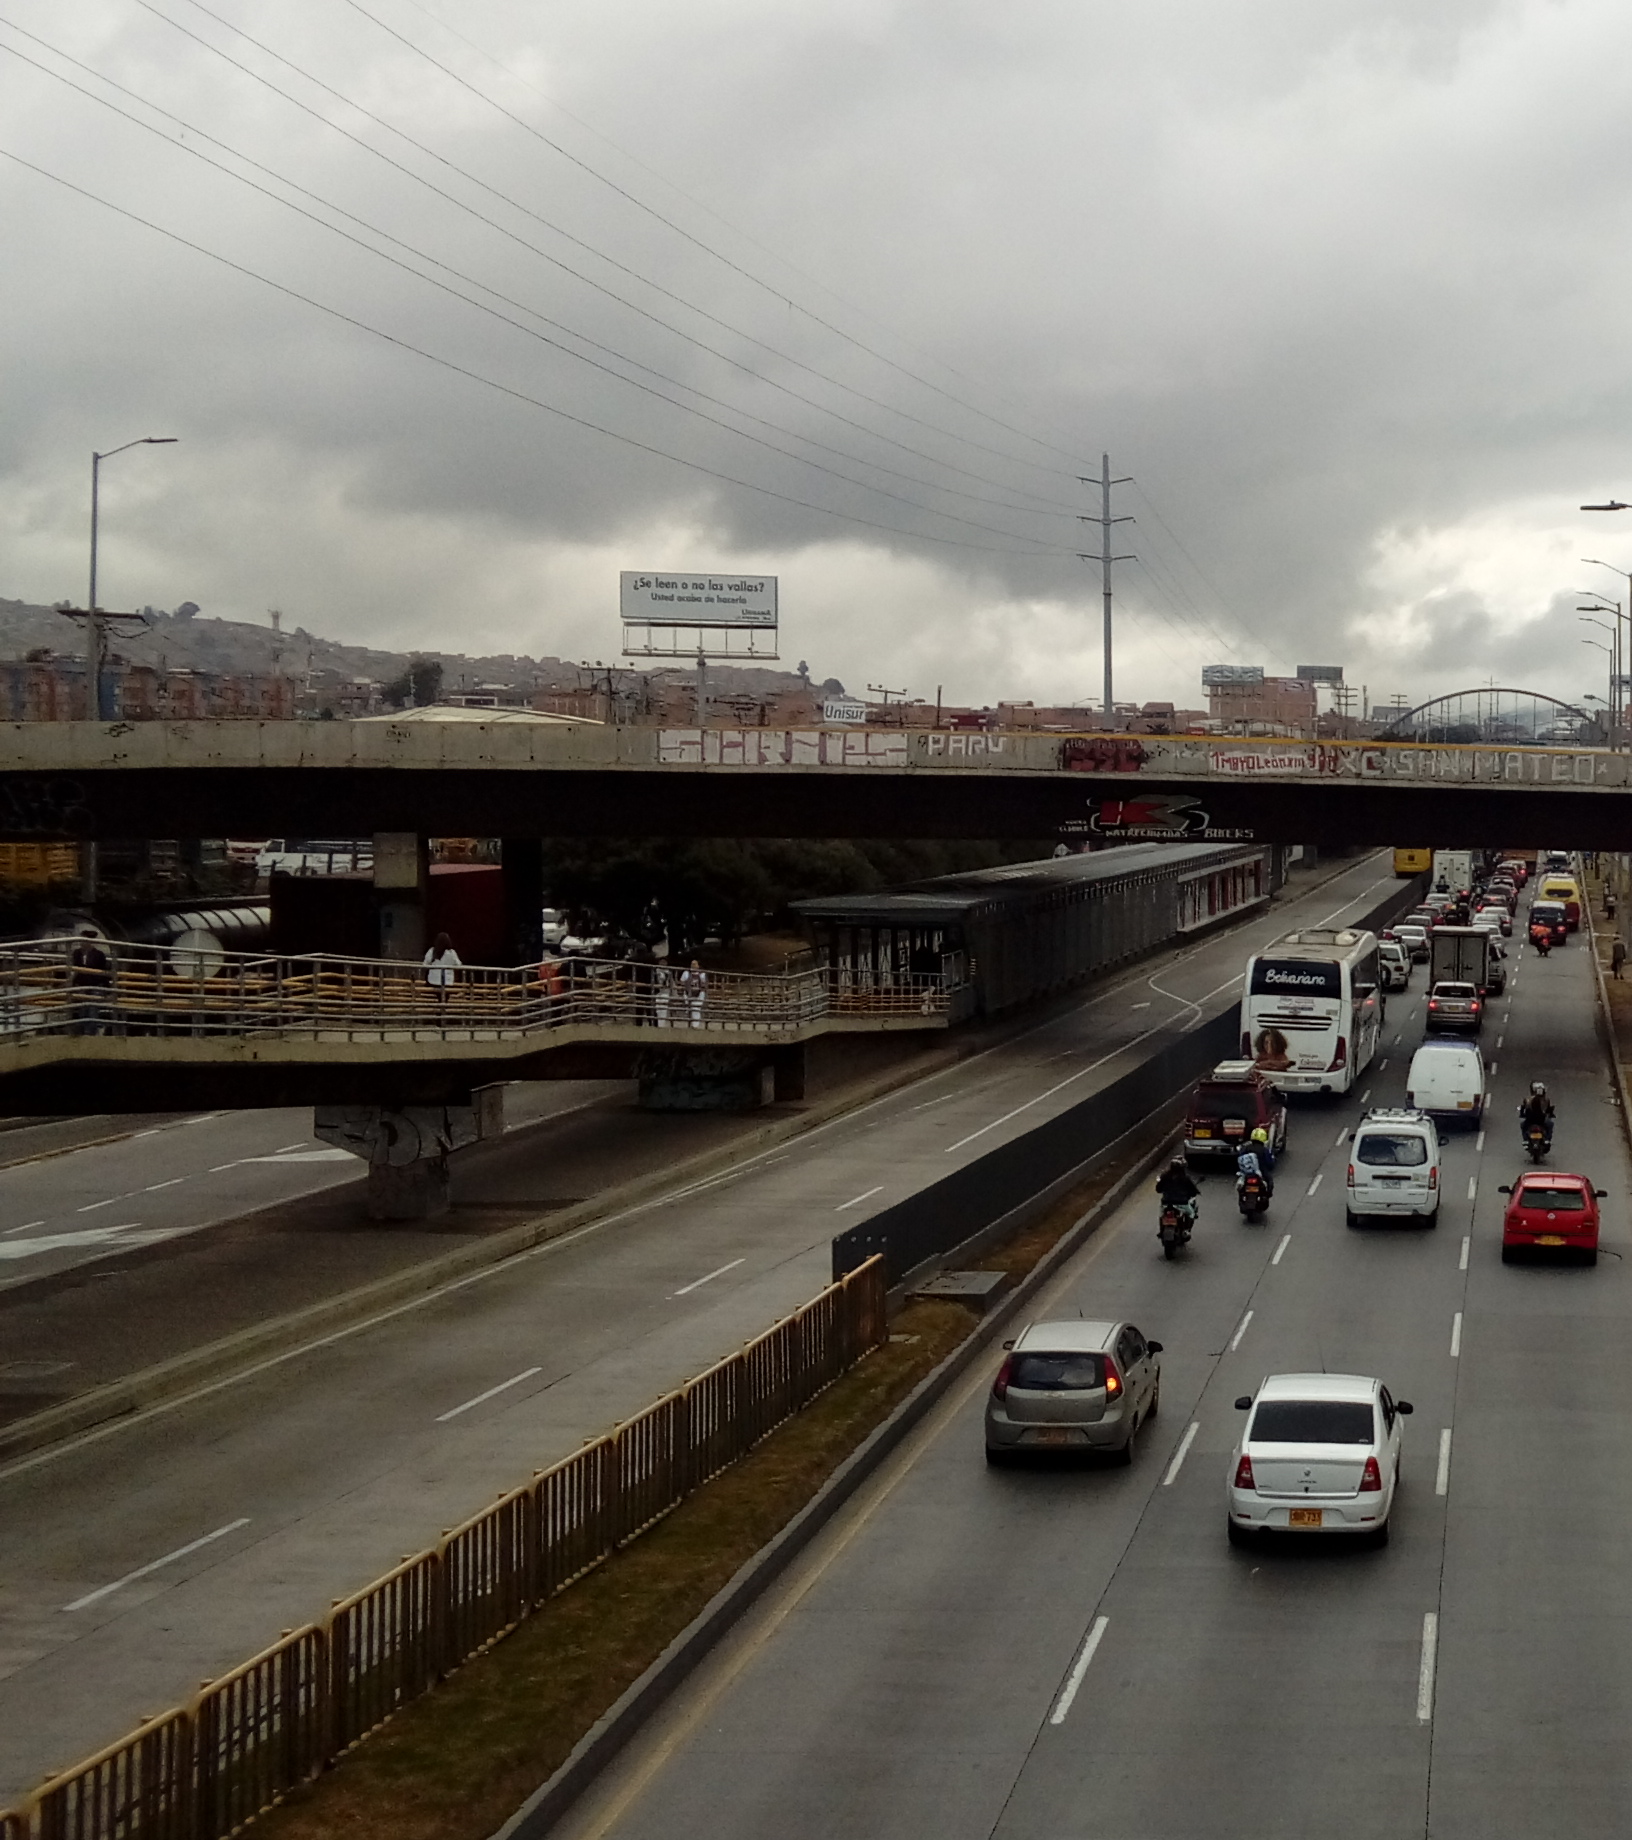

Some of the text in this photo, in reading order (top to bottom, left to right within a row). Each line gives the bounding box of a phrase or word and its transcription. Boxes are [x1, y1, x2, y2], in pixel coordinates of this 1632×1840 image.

[633, 577, 652, 591] ¿Se
[655, 577, 678, 589] leen
[692, 582, 705, 590] no
[708, 579, 723, 591] las
[727, 580, 764, 592] vallas?
[651, 592, 674, 601] Usted
[825, 705, 864, 719] Unisur
[1265, 968, 1326, 986] Bolivariano
